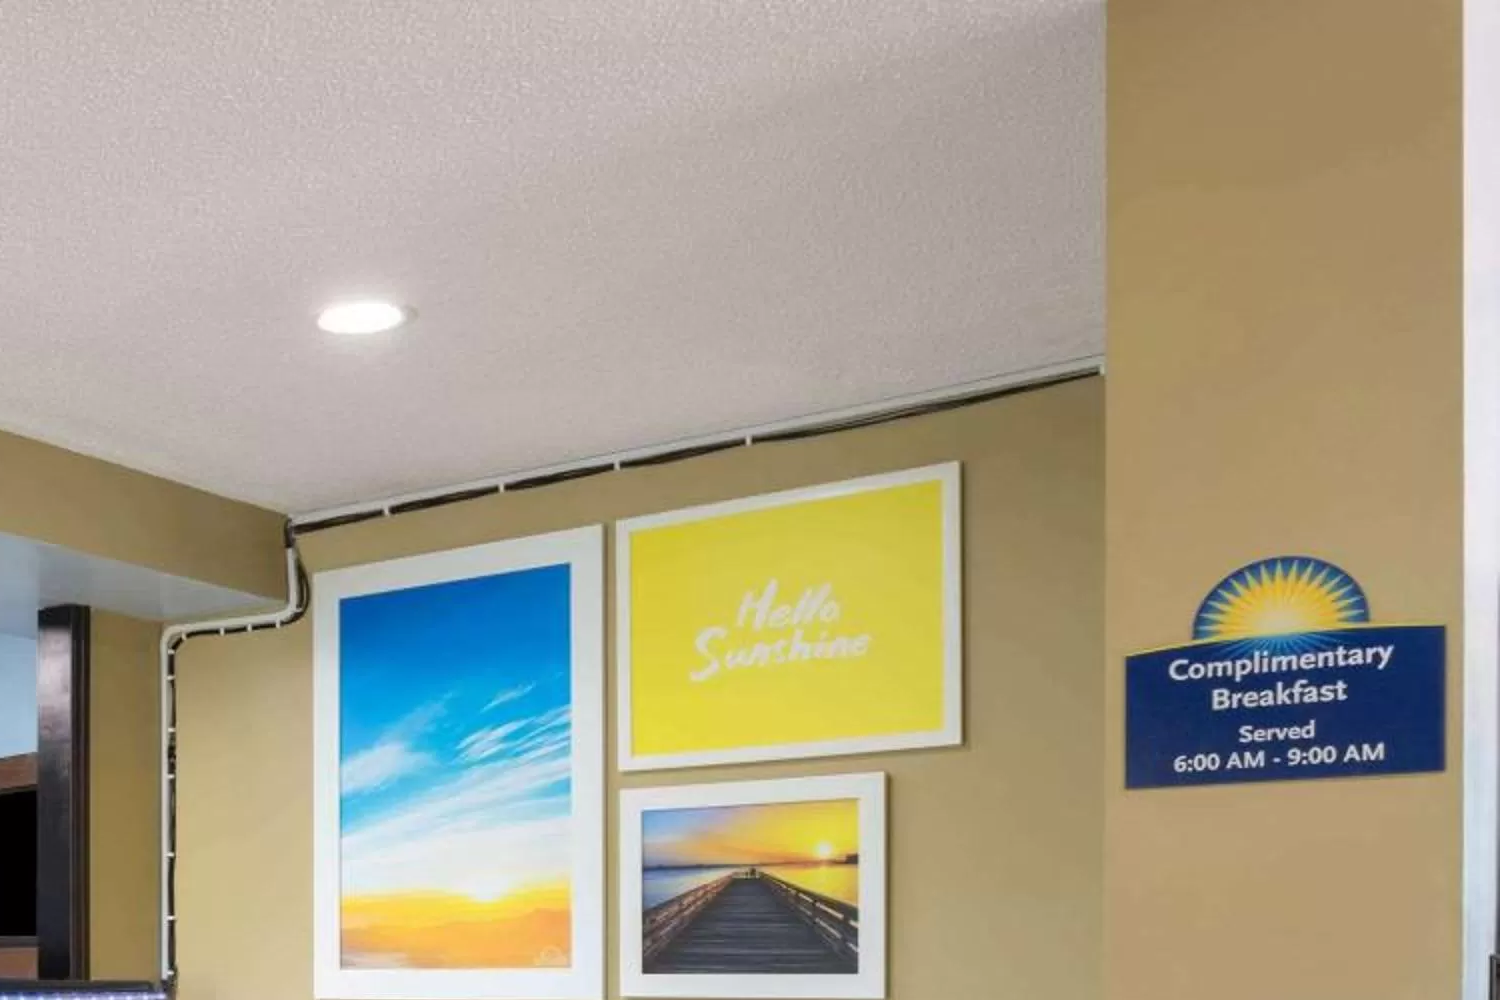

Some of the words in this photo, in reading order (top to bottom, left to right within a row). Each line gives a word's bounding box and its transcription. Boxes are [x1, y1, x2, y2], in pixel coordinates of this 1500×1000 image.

[736, 578, 840, 631] Hello
[690, 625, 871, 682] Sunshine
[1168, 644, 1394, 682] Complimentary
[1211, 679, 1348, 711] Breakfast
[1238, 720, 1316, 743] Served
[1173, 753, 1220, 773] 6:00
[1226, 750, 1265, 769] AM
[1287, 745, 1337, 766] 9:00
[1343, 743, 1385, 762] AM
